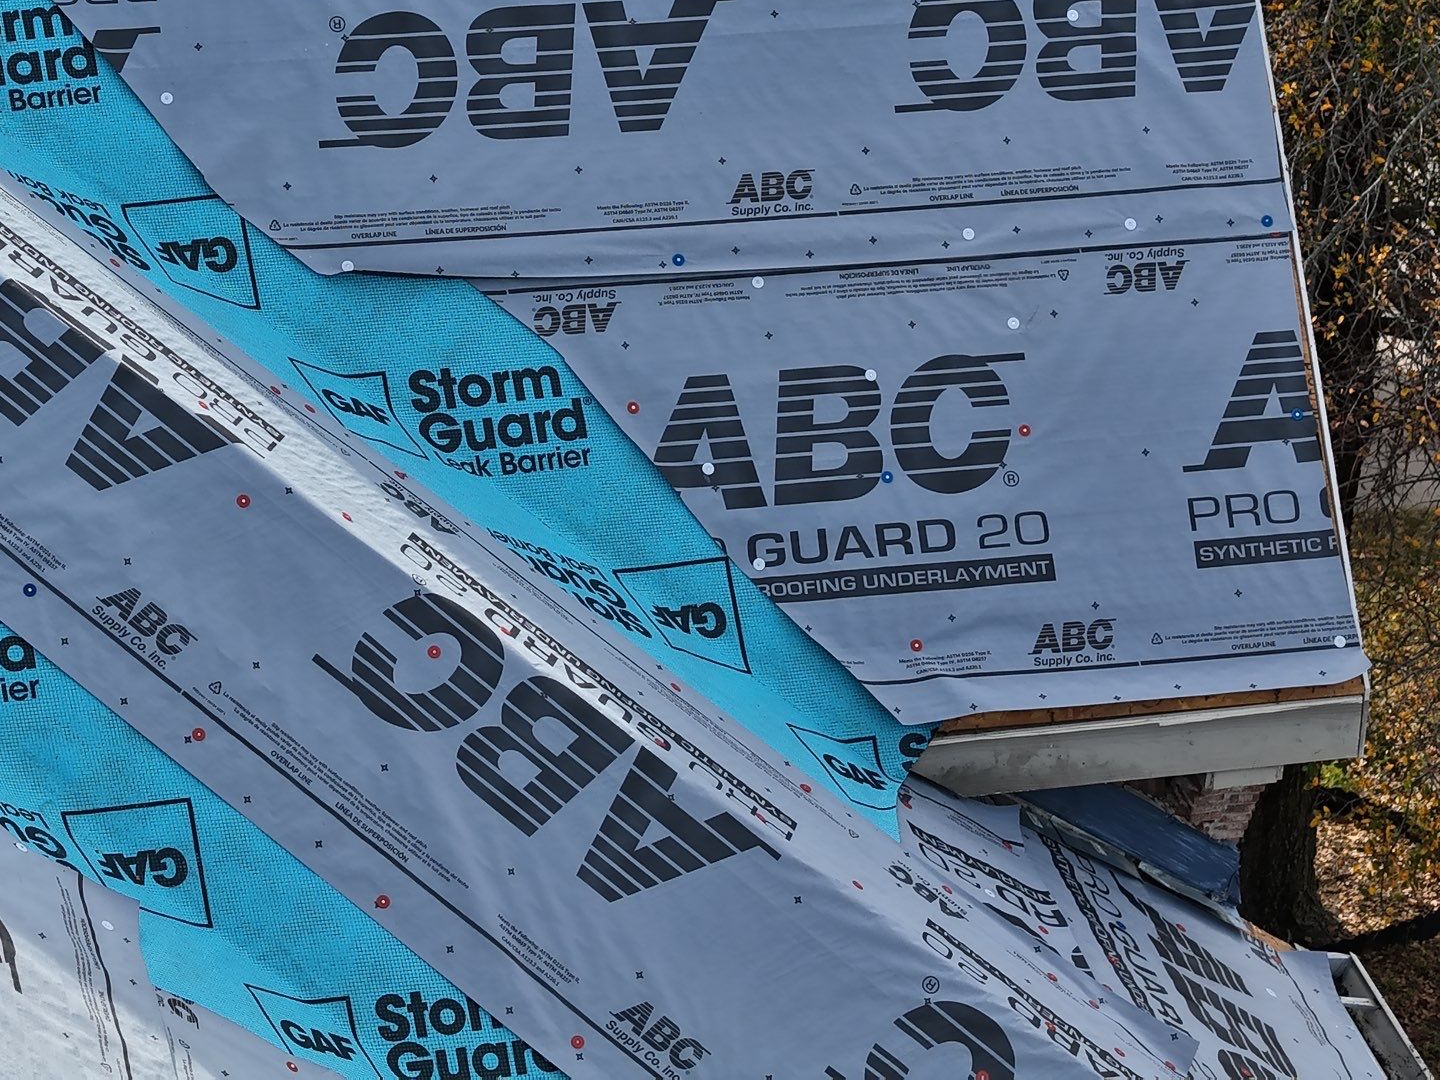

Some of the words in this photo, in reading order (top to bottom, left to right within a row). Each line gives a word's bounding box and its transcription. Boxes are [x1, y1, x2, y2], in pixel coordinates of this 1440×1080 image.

[9, 84, 102, 112] Barrier
[726, 169, 816, 205] ABC
[731, 205, 772, 217] Supply
[351, 231, 381, 240] OVERLAP
[383, 230, 397, 238] LINE
[321, 388, 392, 425] GAF
[409, 365, 563, 414] Storm
[418, 397, 589, 454] Guard
[653, 352, 1026, 510] ABC
[434, 450, 493, 477] Leak
[499, 444, 591, 476] Barrier
[1187, 489, 1301, 532] PRO
[746, 517, 957, 568] GUARD
[977, 510, 1050, 550] 20
[1199, 535, 1322, 562] SYNTHETIC
[863, 560, 1050, 589] UNDERLAYMENT
[91, 604, 130, 639] Supply
[130, 634, 147, 655] Co.
[96, 587, 199, 656] ABC
[1027, 618, 1117, 655] ABC
[1033, 655, 1072, 667] Supply
[312, 592, 782, 904] ABC
[822, 753, 889, 790] GAF
[98, 846, 189, 888] GAF
[280, 1018, 357, 1062] GAF
